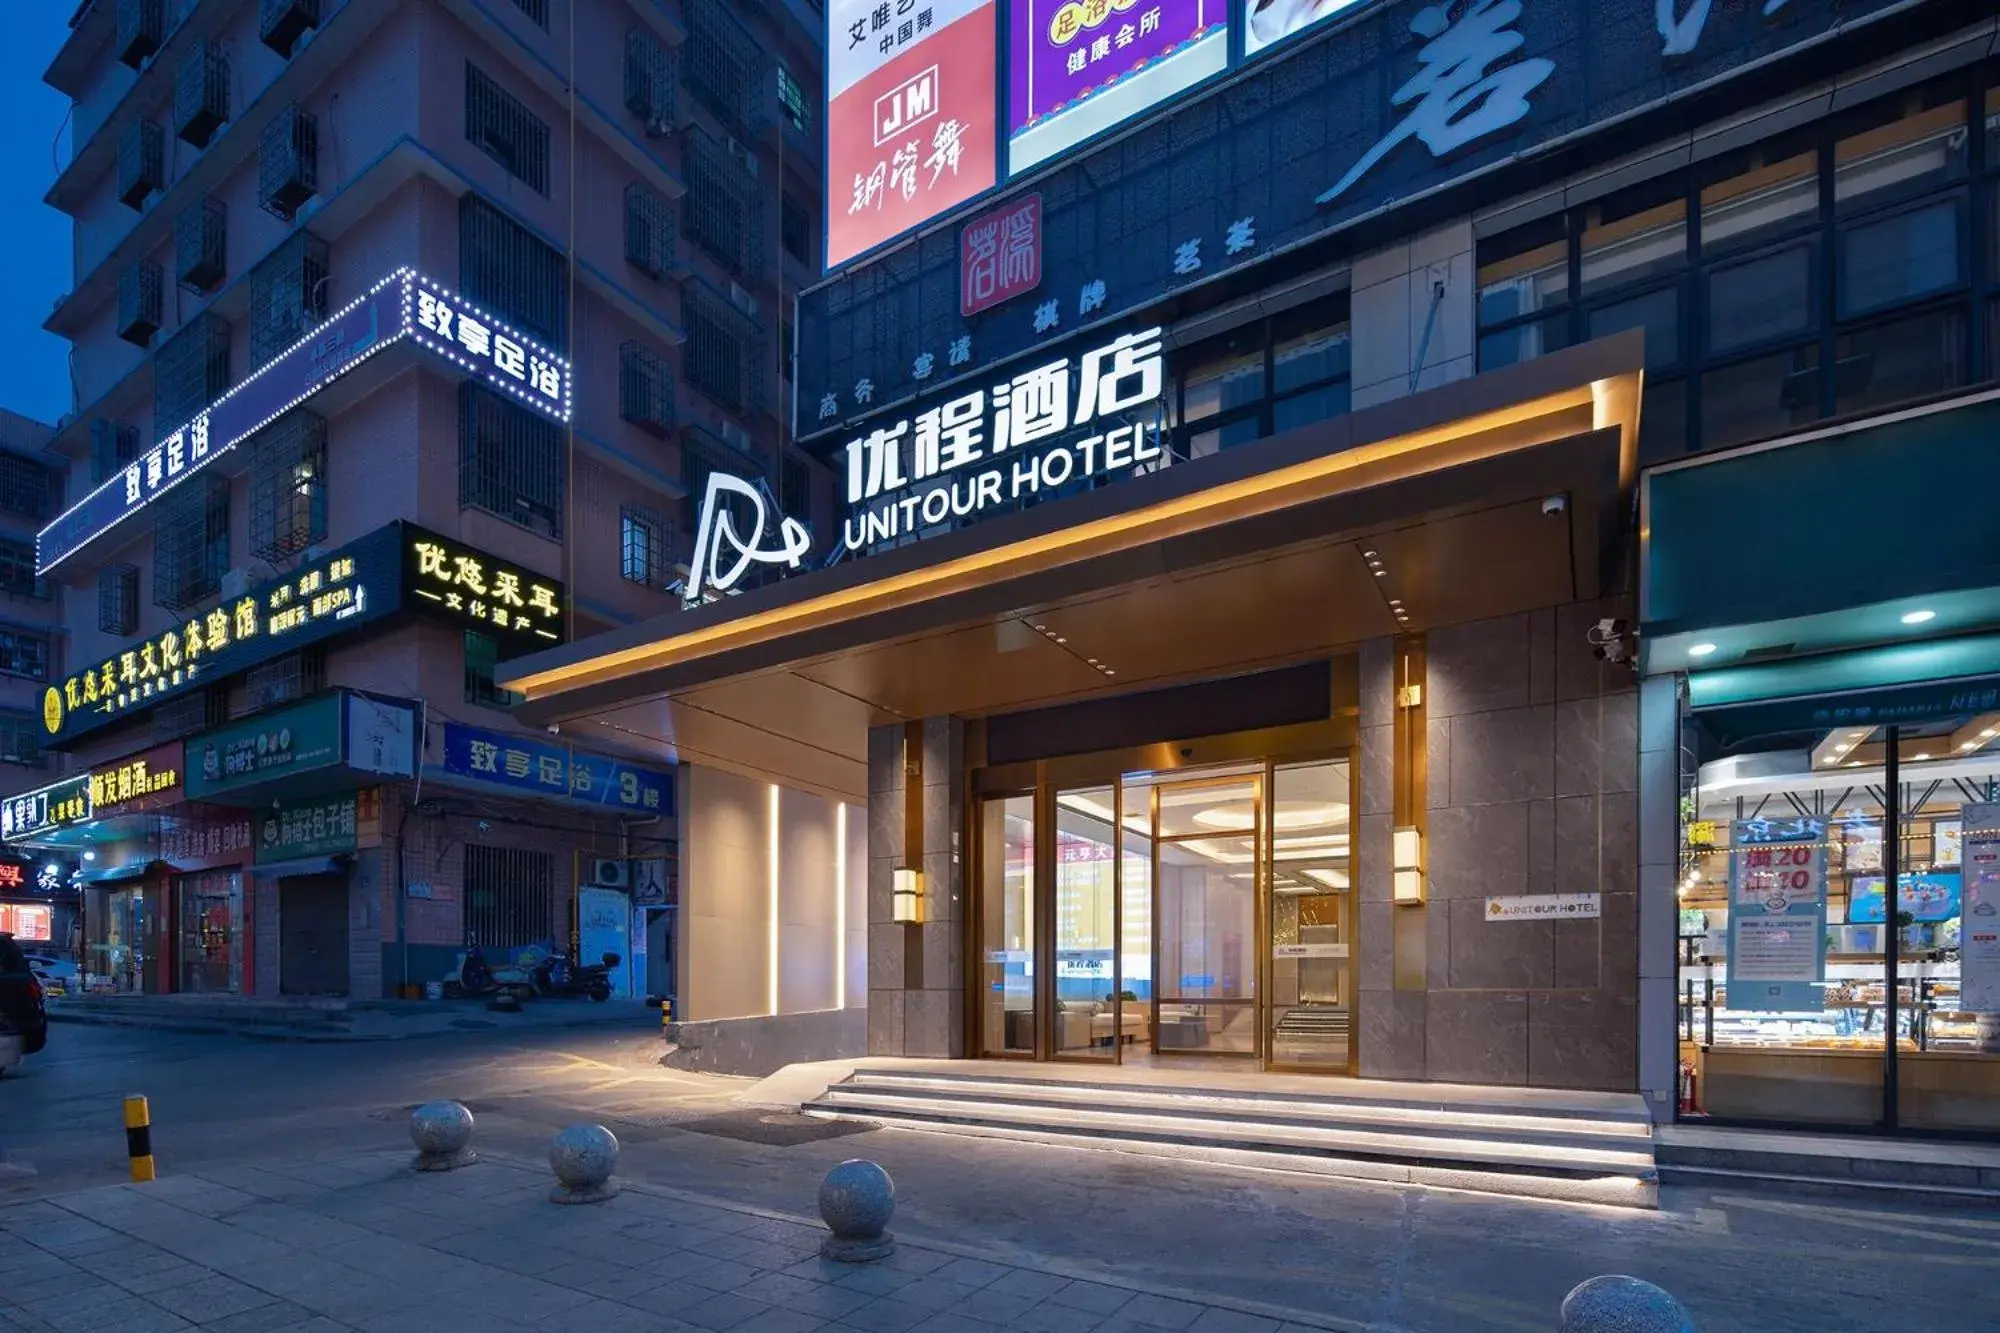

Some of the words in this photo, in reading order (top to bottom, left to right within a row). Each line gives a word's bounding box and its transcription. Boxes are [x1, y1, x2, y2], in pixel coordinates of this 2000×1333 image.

[879, 6, 933, 54] 中国舞
[1066, 6, 1161, 76] 健康会所
[883, 85, 931, 135] JM
[848, 118, 971, 216] 钢管舞
[418, 289, 560, 399] 致享足浴
[846, 326, 1163, 503] 优程酒店
[126, 415, 209, 505] 致享足浴
[844, 470, 1002, 551] UNITOUR
[1012, 421, 1161, 499] HOTEL
[415, 543, 559, 617] 优悠采耳
[445, 592, 531, 631] 文化遗产
[65, 596, 258, 711] 优悠采耳文化体验馆
[92, 761, 146, 807] 顺发烟酒
[470, 740, 592, 792] 致享足浴
[1559, 903, 1598, 913] HOTEL
